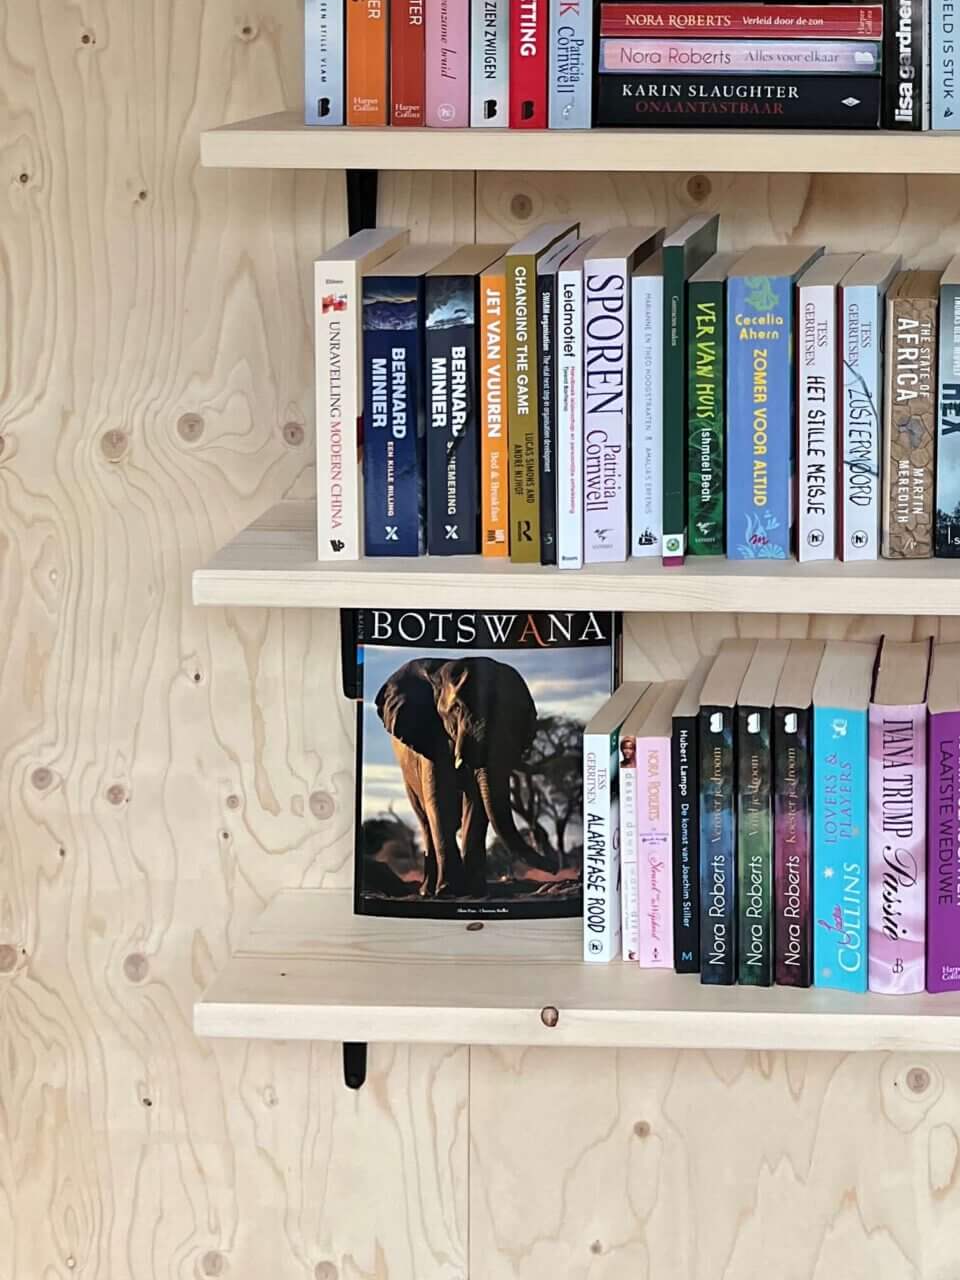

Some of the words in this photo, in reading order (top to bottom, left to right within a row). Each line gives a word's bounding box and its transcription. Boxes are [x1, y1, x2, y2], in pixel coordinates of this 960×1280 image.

[485, 2, 496, 28] ZIEN
[625, 15, 664, 26] NORA
[668, 15, 731, 28] ROBERTS
[484, 31, 496, 79] ZWIJGEN
[943, 40, 953, 53] IS
[943, 59, 954, 99] STUK
[515, 267, 527, 343] CHANGING
[563, 284, 575, 357] Leidmotief
[696, 303, 717, 338] VER
[586, 275, 624, 414] SPOREN
[919, 323, 930, 344] THE
[329, 321, 342, 418] UNRAVELLING
[517, 345, 528, 371] THE
[696, 341, 715, 379] VAN
[753, 349, 767, 403] ZOMER
[896, 318, 918, 401] AFRICA
[919, 348, 930, 380] STATE
[372, 358, 386, 427] MINIER
[392, 348, 406, 438] BERNARD
[517, 374, 529, 415] GAME
[696, 384, 715, 418] HUIS
[919, 384, 930, 397] OF
[331, 421, 342, 481] MODERN
[701, 428, 712, 471] Ishmael
[753, 408, 767, 455] VOOR
[586, 430, 608, 511] Cornwell
[604, 445, 621, 497] Patricia
[701, 474, 712, 501] Beah
[753, 460, 767, 506] ALTIJD
[331, 484, 342, 528] CHINA
[371, 611, 606, 647] BOTSWANA
[679, 730, 689, 763] Hubert
[882, 719, 913, 769] IVANA
[679, 765, 689, 796] Lampo
[682, 804, 689, 816] De
[882, 774, 913, 838] TRUMP
[682, 818, 690, 843] komst
[587, 813, 605, 892] ALARMFASE
[682, 864, 692, 900] Joachim
[785, 856, 800, 917] Roberts
[881, 846, 917, 941] Passie
[589, 897, 606, 933] ROOD
[682, 902, 692, 927] Stiller
[785, 925, 800, 965] Nora
